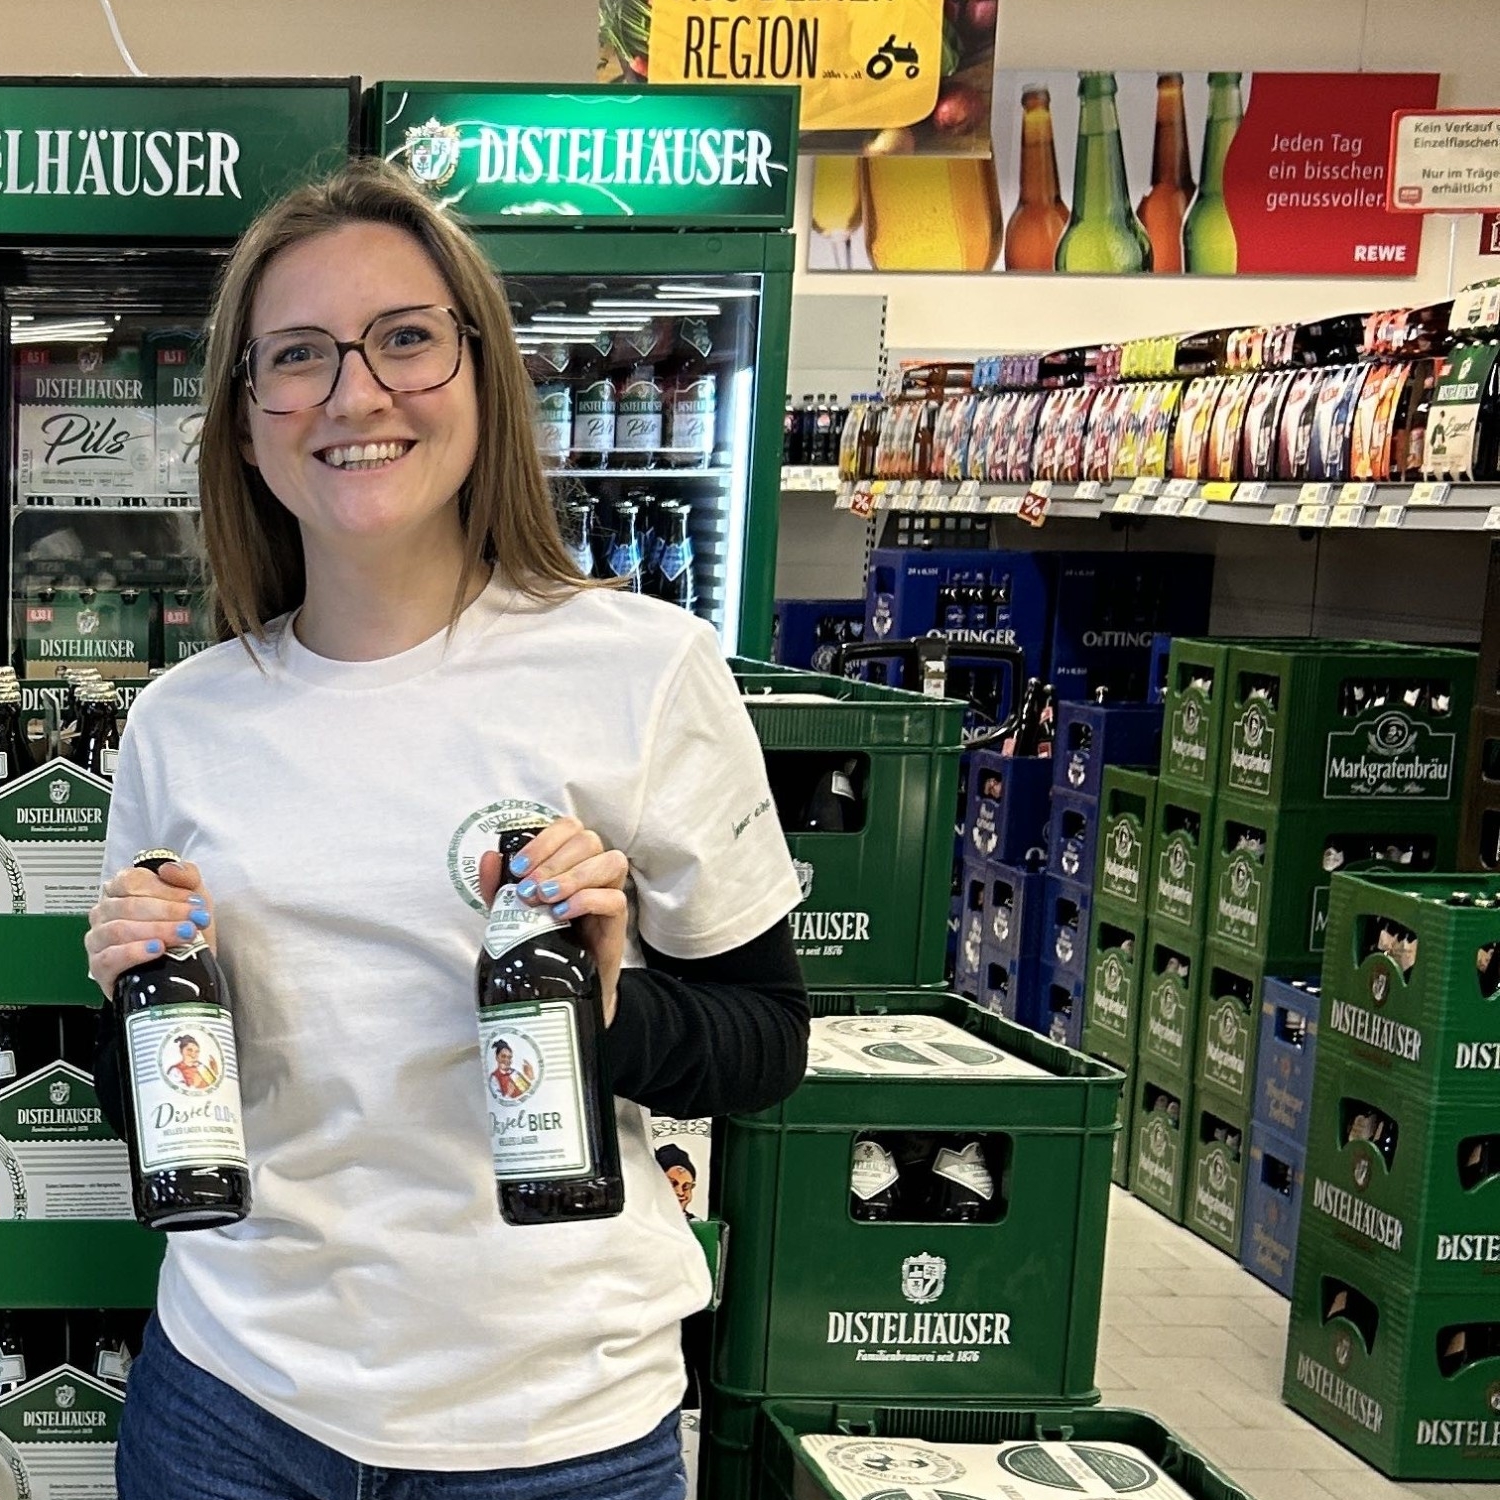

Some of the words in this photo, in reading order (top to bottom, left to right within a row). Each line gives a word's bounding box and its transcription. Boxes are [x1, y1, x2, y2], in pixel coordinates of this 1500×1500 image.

[683, 15, 819, 80] REGION
[1414, 122, 1441, 133] Kein
[1445, 121, 1494, 132] Verkauf
[1271, 134, 1323, 152] Jeden
[1330, 134, 1362, 155] Tag
[476, 127, 773, 188] DISTELHÄUSER
[1269, 162, 1297, 180] ein
[1305, 161, 1384, 180] bisschen
[1422, 168, 1444, 178] Nur
[1448, 168, 1462, 178] im
[1466, 168, 1500, 180] Träge
[1266, 190, 1386, 211] genussvoller.
[1354, 245, 1406, 262] REWE
[35, 377, 143, 400] DISTELHÄUSER
[41, 413, 150, 466] Pils
[40, 638, 135, 659] DISTELHÄUSER
[1329, 755, 1448, 785] Markgrafenbräu
[16, 807, 103, 824] DISTELHÄUSER
[787, 911, 870, 941] HÄUSER
[1330, 999, 1422, 1062] DISTELHÄUSER
[16, 1108, 102, 1125] DISTELHÄUSER
[153, 1100, 211, 1130] Distel
[529, 1111, 563, 1132] BIER
[1313, 1177, 1404, 1251] DISTELHÄUSER
[827, 1311, 1011, 1345] DISTELHÄUSER
[1297, 1353, 1383, 1434] DISTELHÄUSER
[23, 1411, 107, 1427] DISTELHÄUSER
